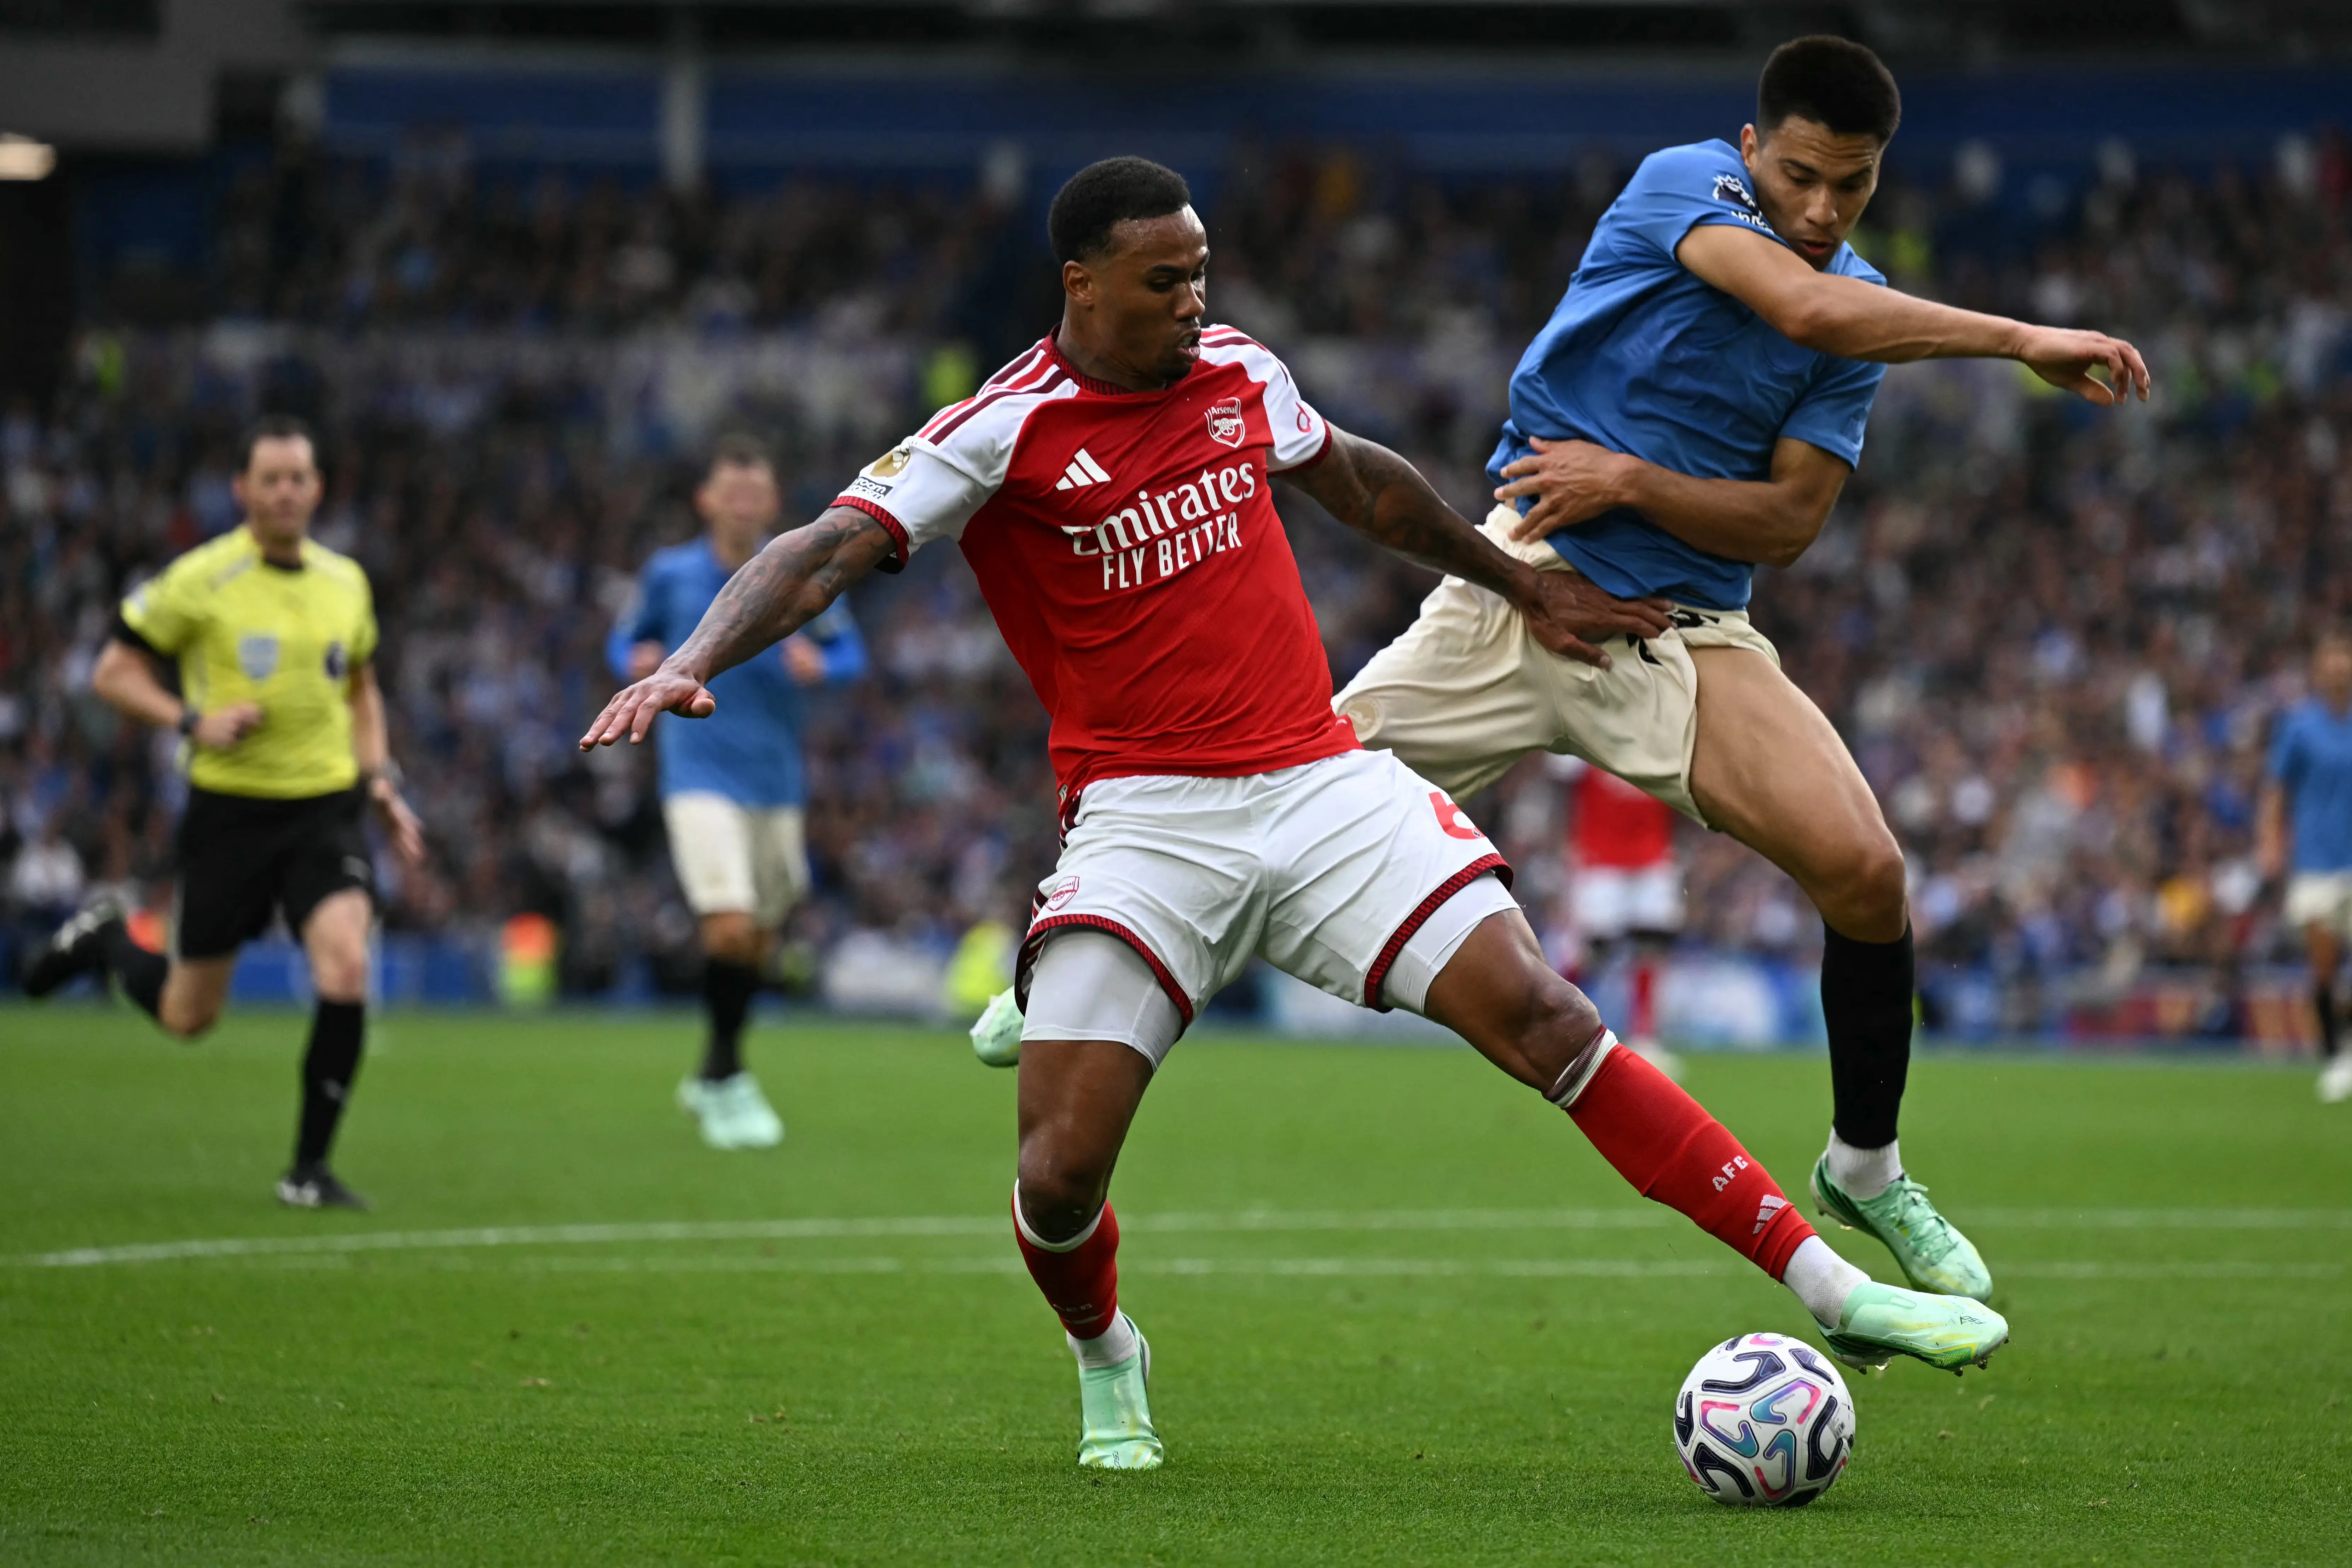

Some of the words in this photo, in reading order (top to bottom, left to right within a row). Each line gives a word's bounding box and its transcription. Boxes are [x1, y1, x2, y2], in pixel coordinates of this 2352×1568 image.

[1211, 405, 1236, 414] Arsenal
[1061, 463, 1255, 556] Emirates
[1102, 547, 1145, 590] FLY
[1158, 512, 1242, 577] BETTER
[1712, 1155, 1748, 1192] AFC
